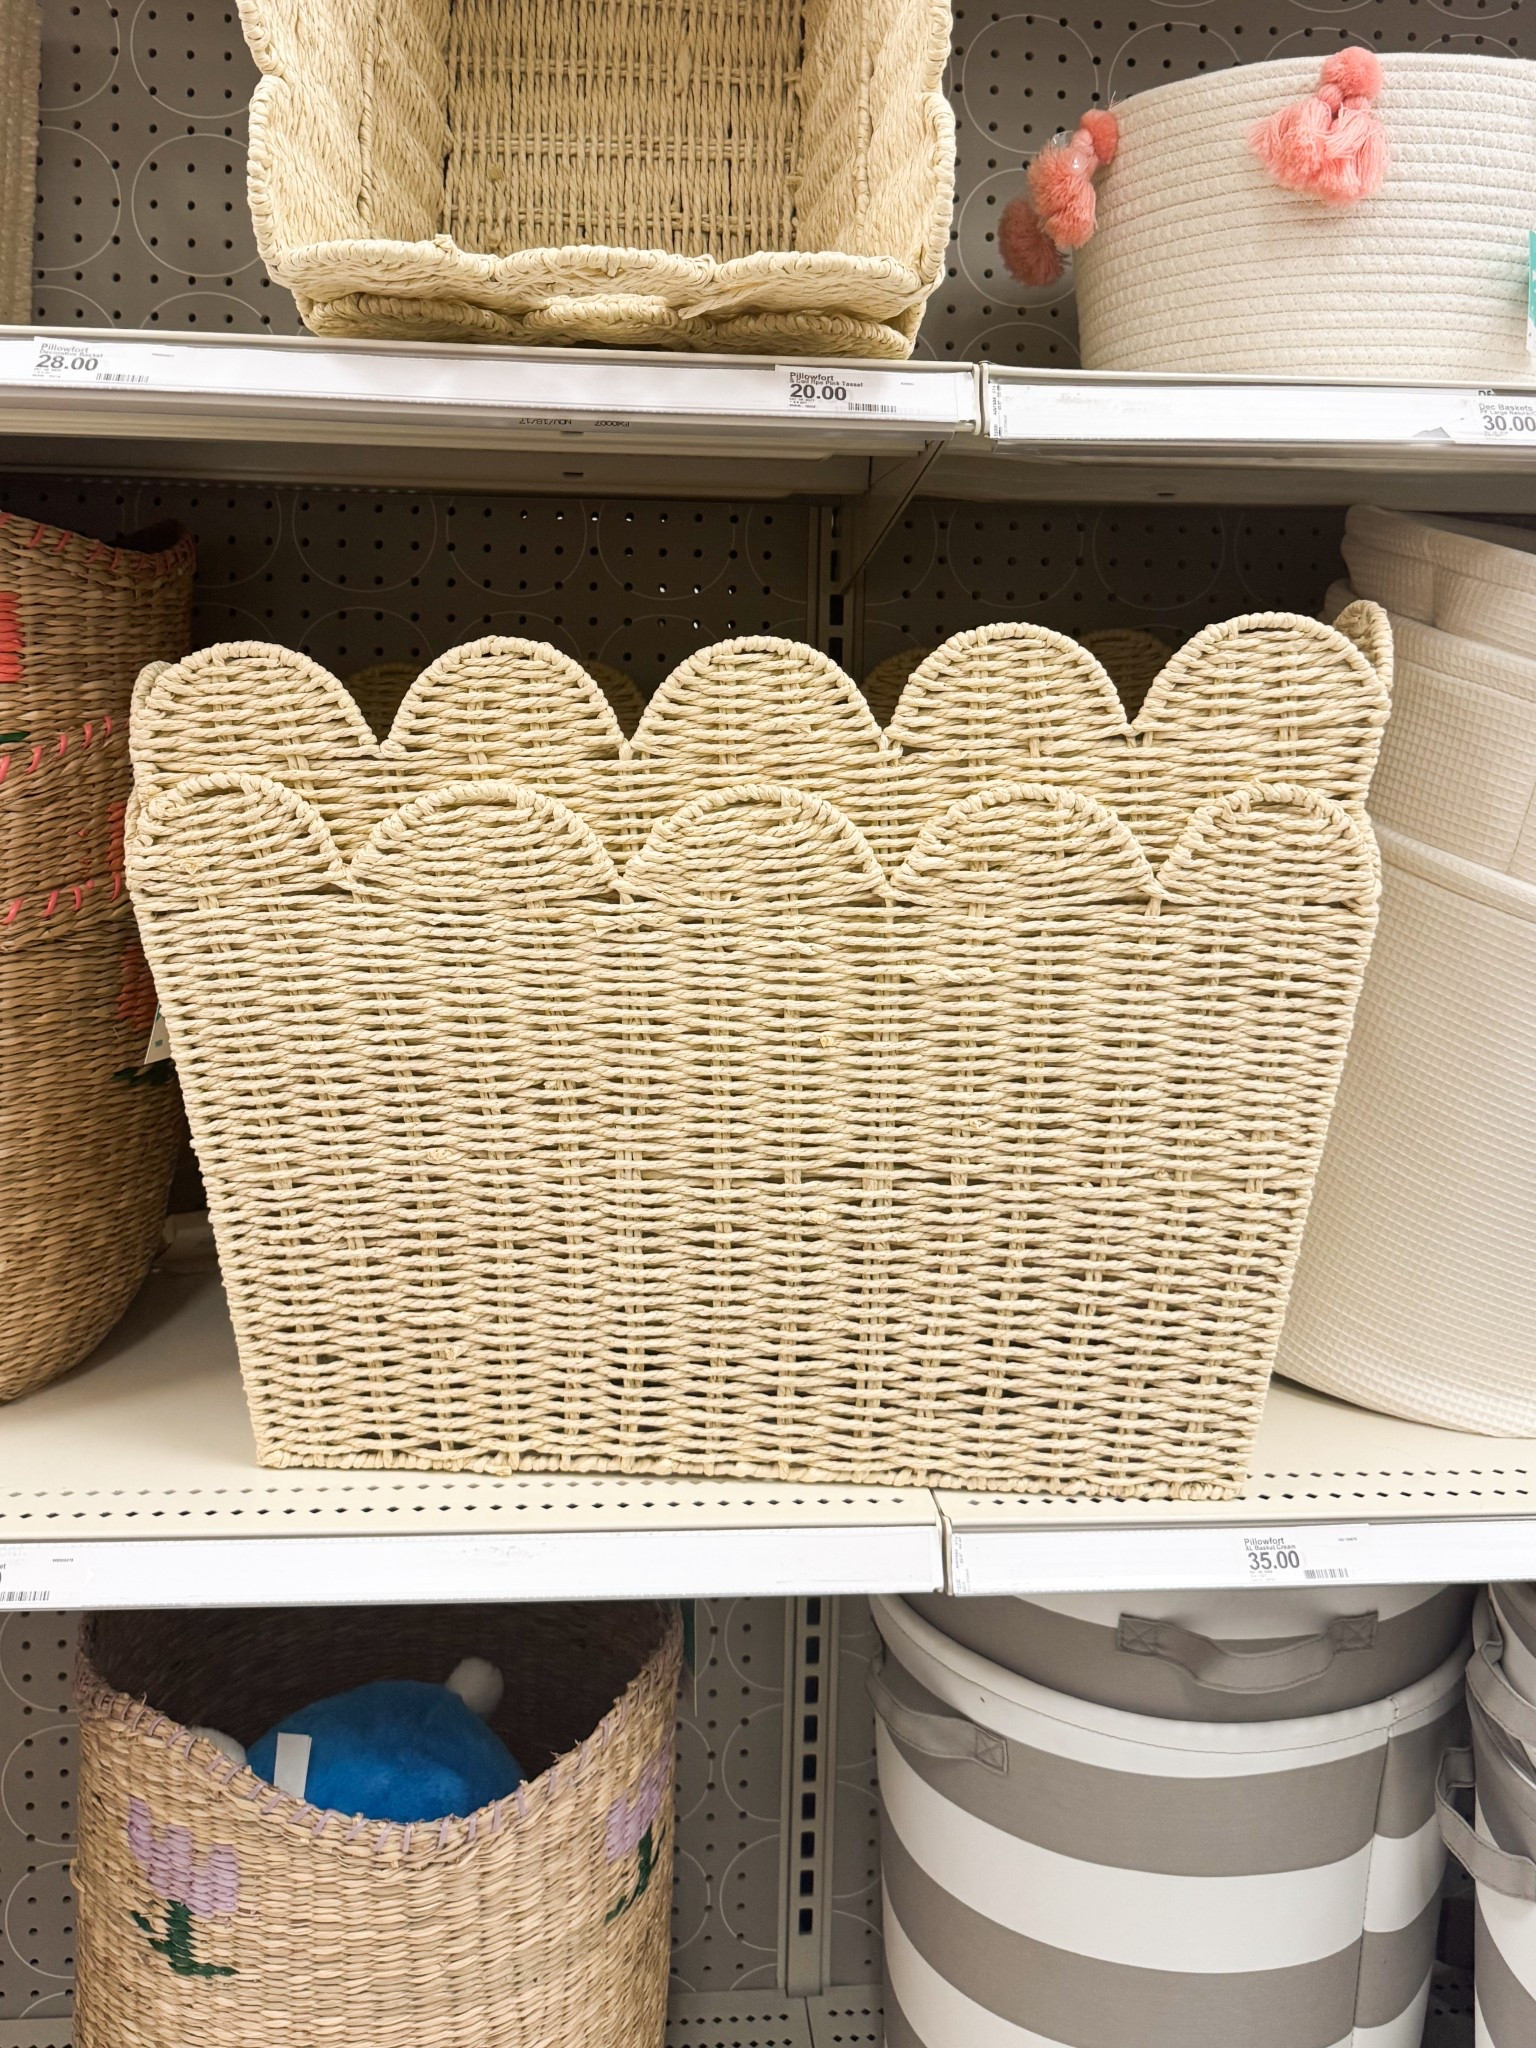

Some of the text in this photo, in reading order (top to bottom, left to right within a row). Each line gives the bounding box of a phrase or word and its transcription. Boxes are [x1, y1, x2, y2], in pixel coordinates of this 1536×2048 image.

[40, 343, 88, 353] Pillowfort
[35, 354, 99, 371] 28.00
[789, 371, 834, 381] Pillowfort
[790, 383, 847, 401] 20.00
[1479, 403, 1533, 412] Dec Baskets
[1483, 415, 1536, 432] 30.00
[1244, 1537, 1285, 1546] Pillowfort
[1248, 1550, 1300, 1570] 35.00
